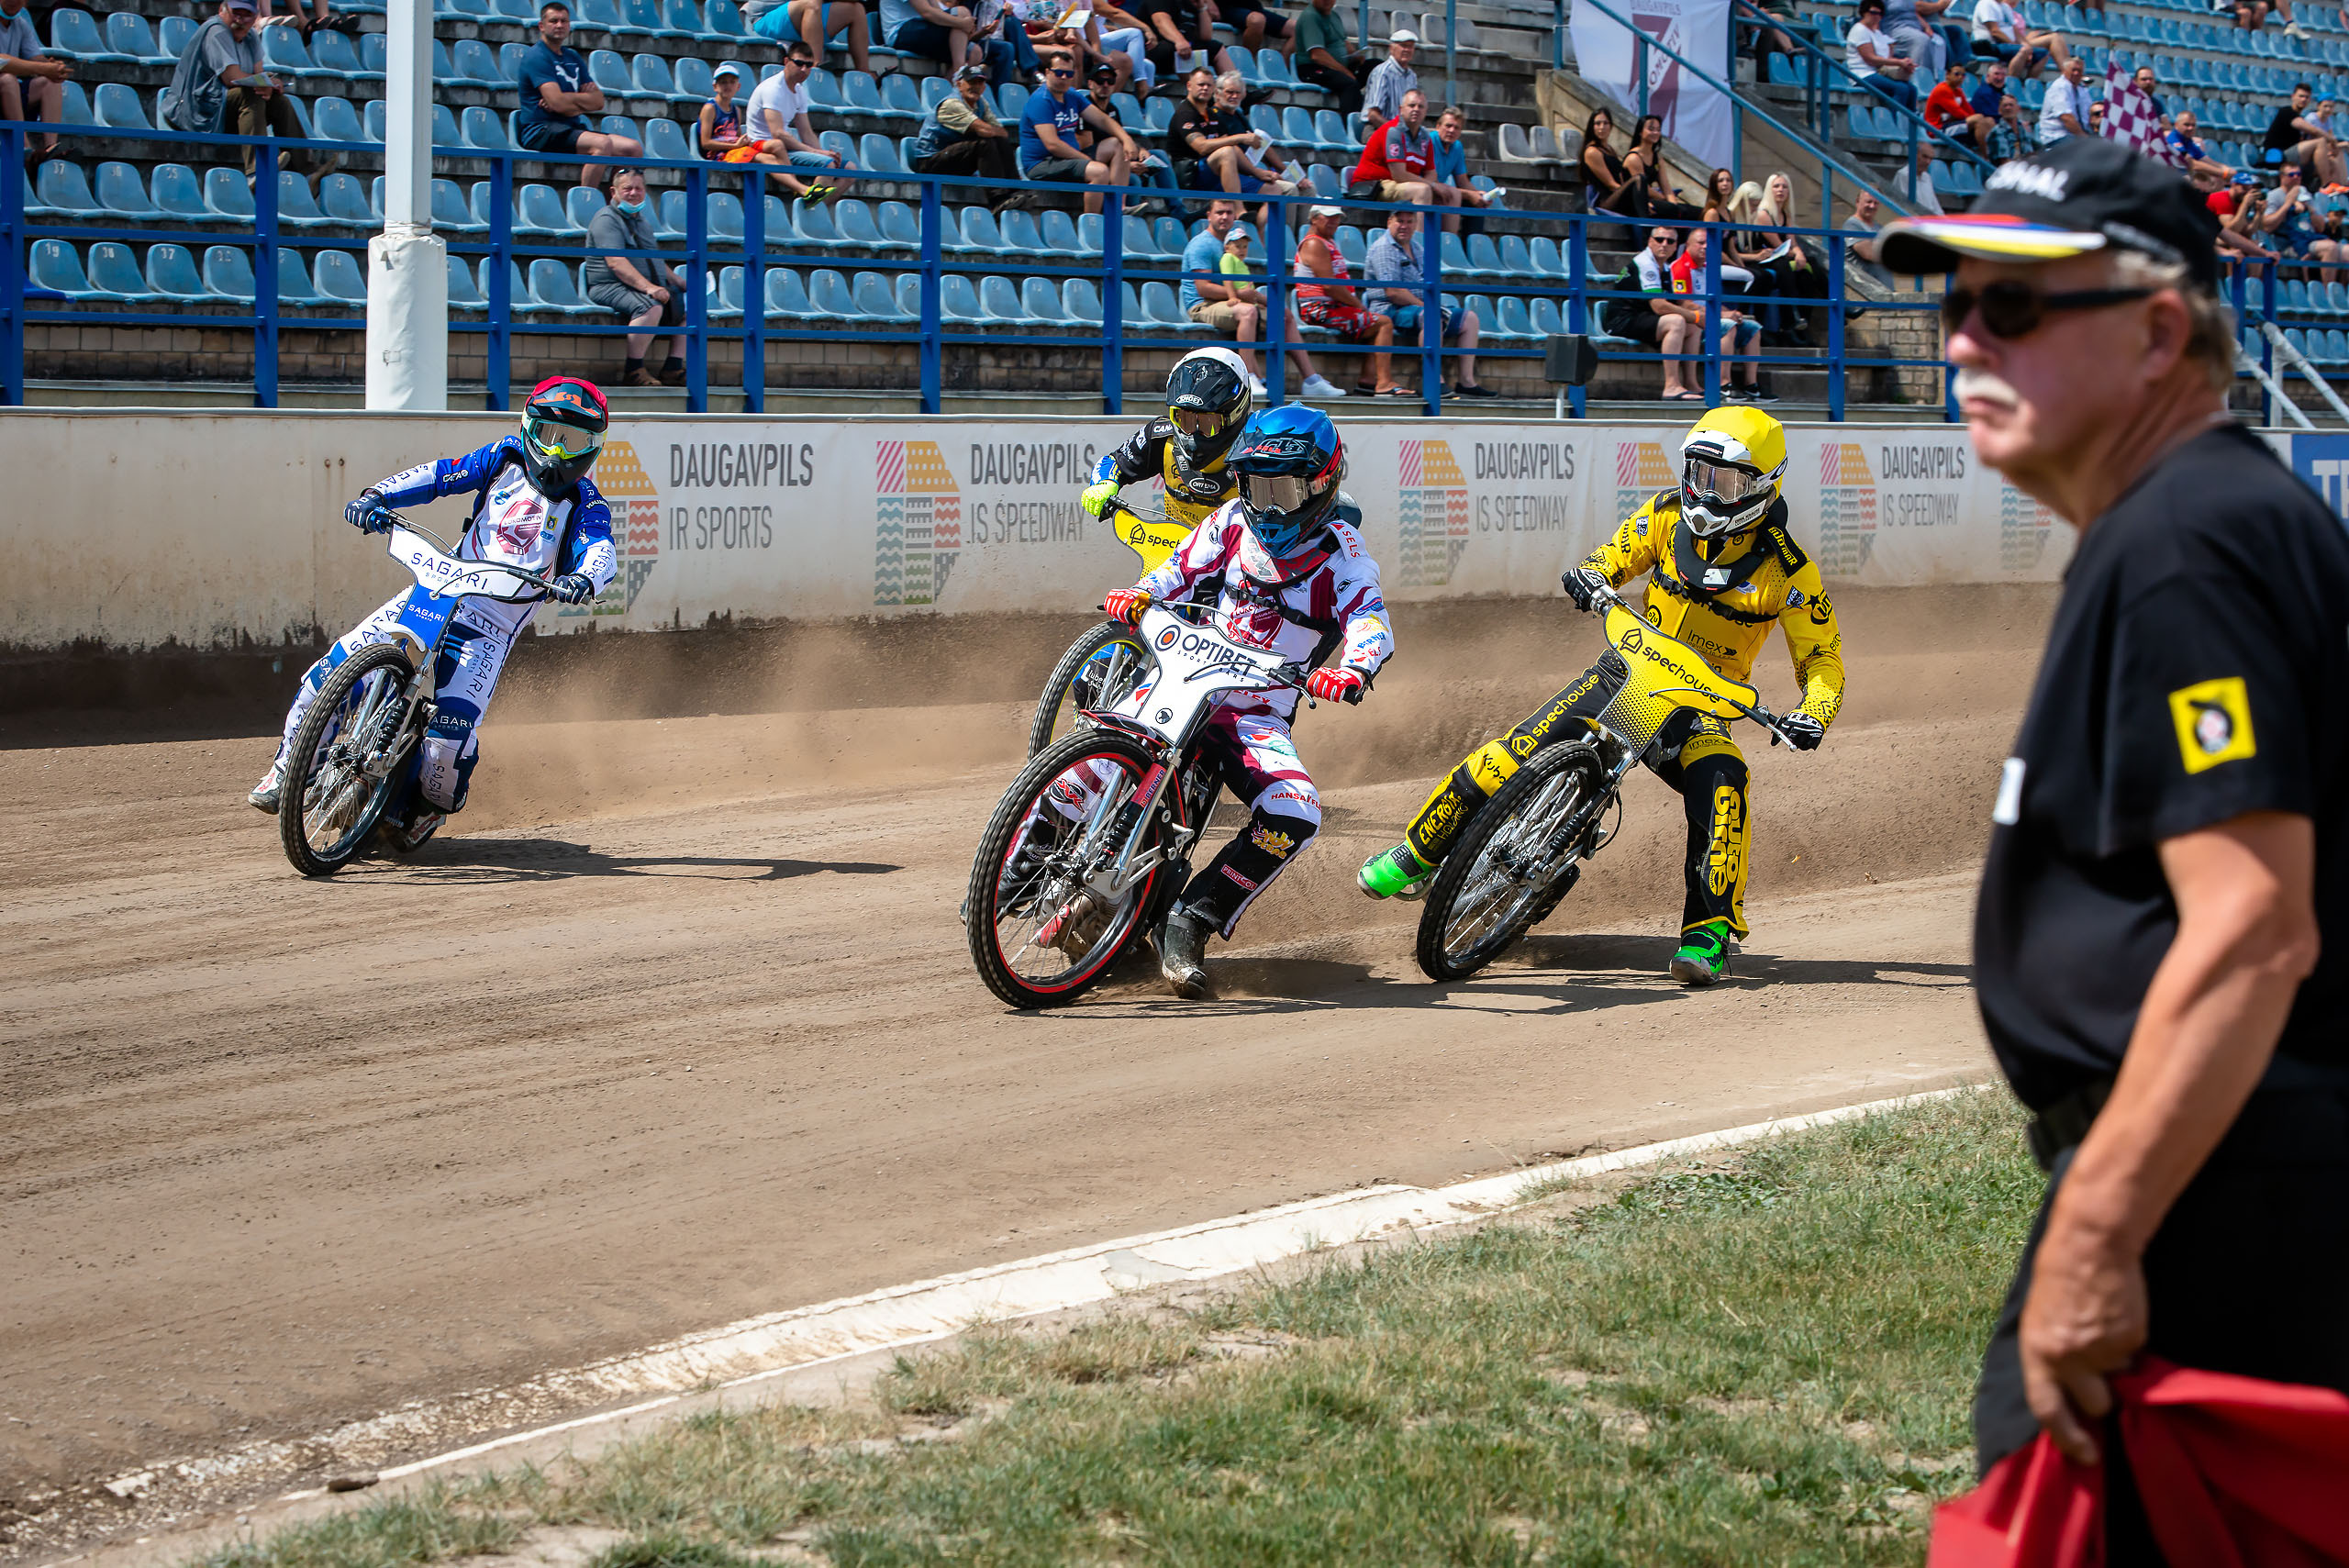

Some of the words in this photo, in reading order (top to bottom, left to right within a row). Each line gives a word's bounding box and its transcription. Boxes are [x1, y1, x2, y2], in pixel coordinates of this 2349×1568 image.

[670, 443, 814, 487] DAUGAVPILS
[971, 443, 1096, 484] DAUGAVPILS
[1475, 442, 1575, 479] DAUGAVPILS
[1882, 446, 1965, 479] DAUGAVPILS
[1192, 482, 1217, 490] ORTEMA
[670, 507, 688, 550] IR
[696, 506, 774, 550] SPORTS
[971, 503, 989, 544] IS
[995, 502, 1086, 543] SPEEDWAY
[1476, 495, 1490, 531] IS
[1496, 495, 1568, 531] SPEEDWAY
[1882, 494, 1894, 527] IS
[1898, 494, 1959, 526] SPEEDWAY
[1342, 530, 1361, 558] SELS
[411, 552, 488, 590] SAGARI
[425, 572, 460, 588] SPORS
[407, 604, 445, 623] SAGARI
[1183, 634, 1258, 676] OPTIBET
[1687, 629, 1723, 653] Imex
[465, 642, 495, 698] SAGARI
[1642, 646, 1720, 704] spechouse
[429, 716, 473, 728] AGARI
[1532, 674, 1599, 738] spechouse
[1146, 769, 1166, 799] BERNER
